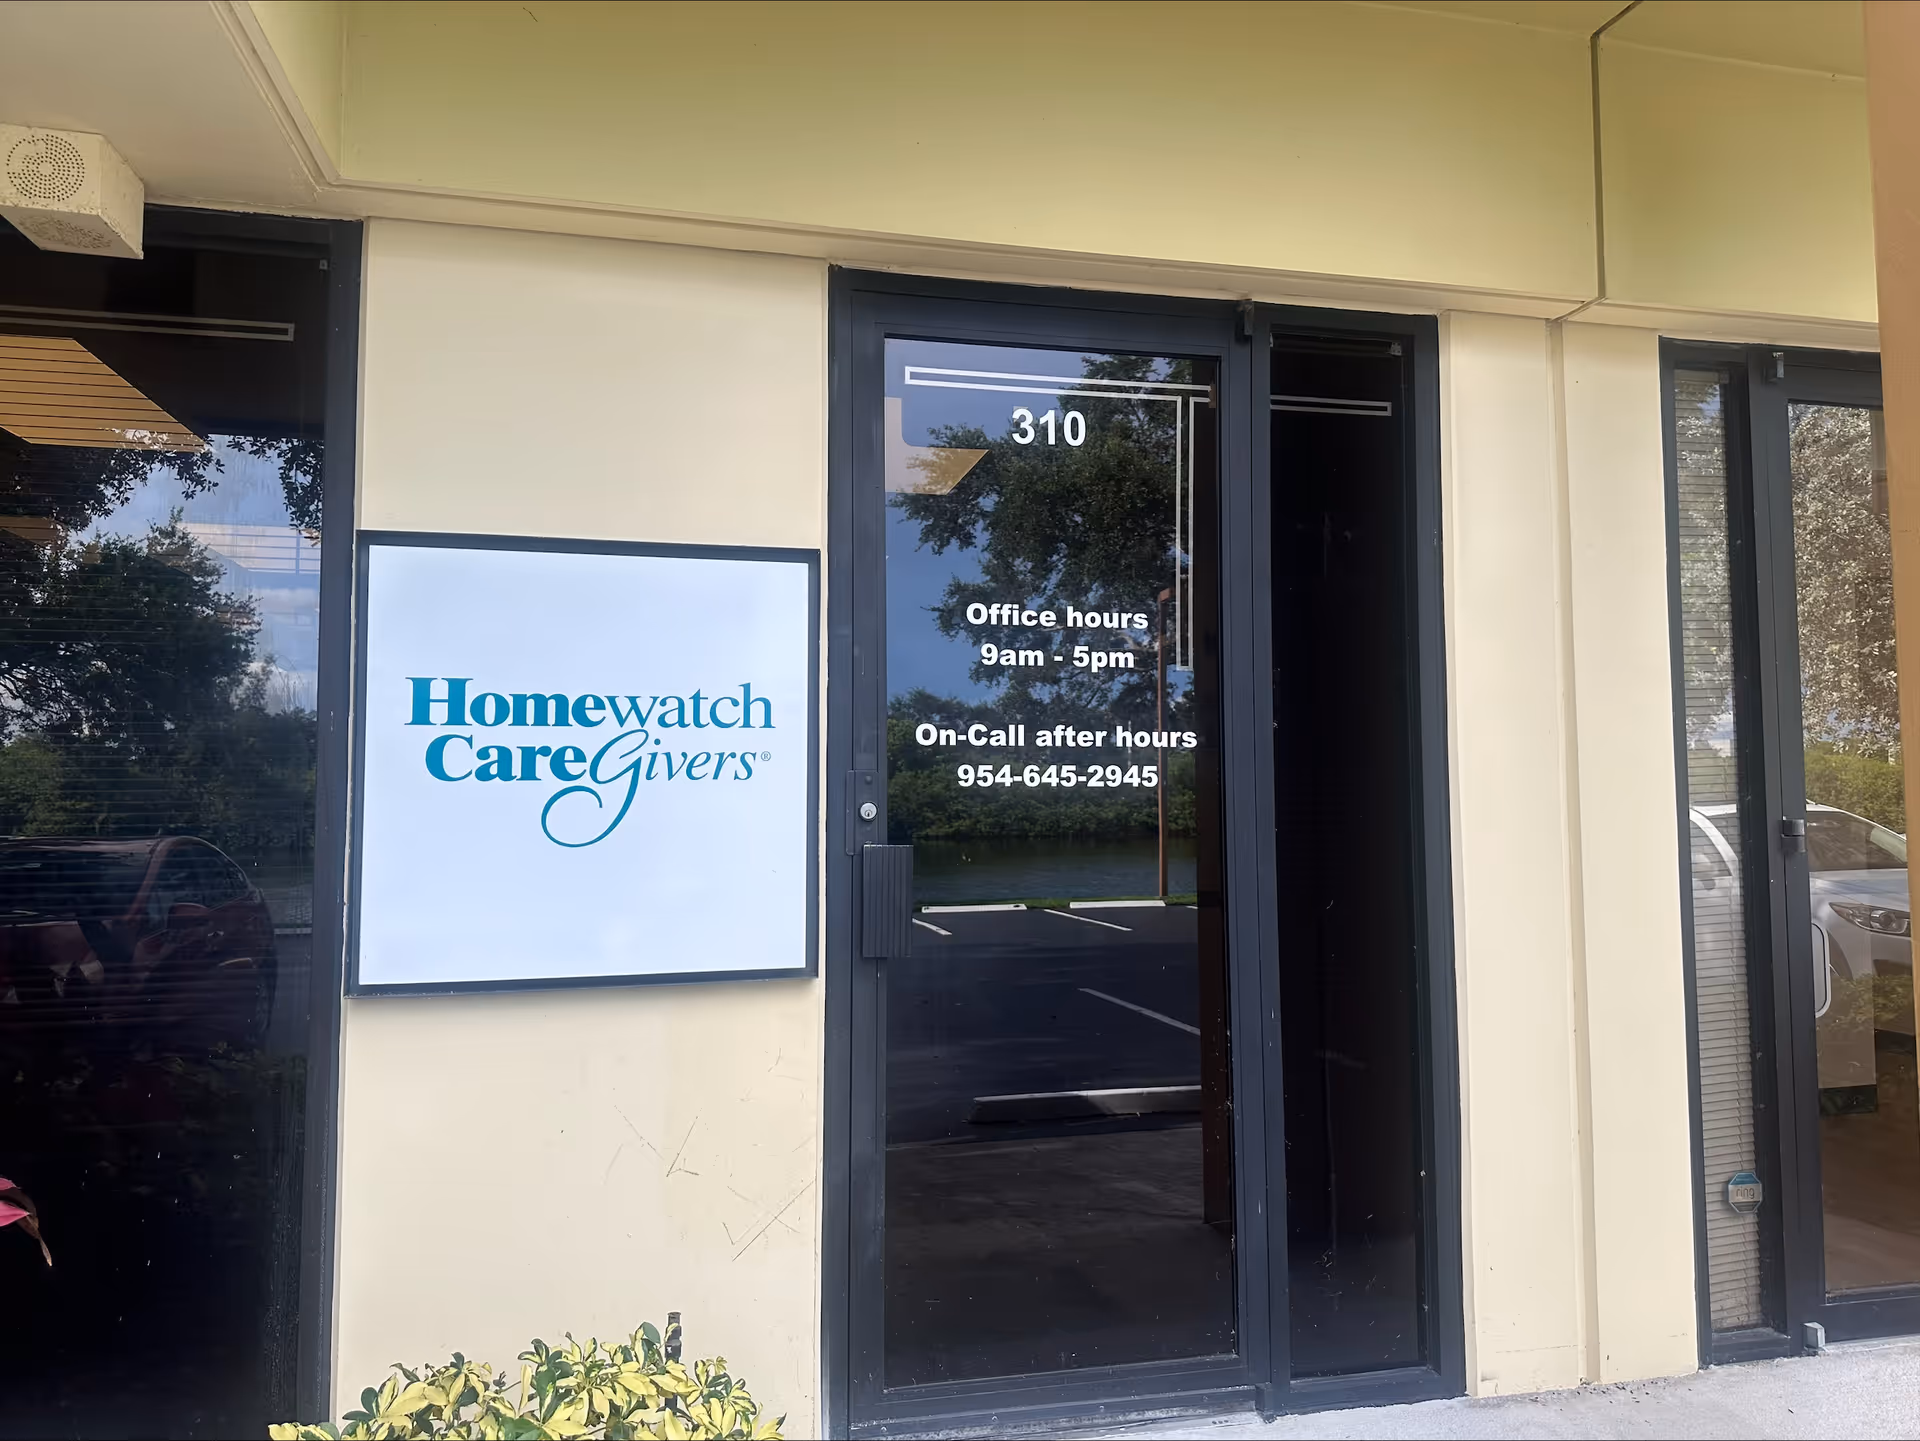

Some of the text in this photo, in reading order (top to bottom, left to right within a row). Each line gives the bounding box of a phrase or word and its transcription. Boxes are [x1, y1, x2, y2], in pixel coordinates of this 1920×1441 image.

[1011, 407, 1087, 447] 310
[966, 602, 1149, 630] Office hours
[980, 643, 1044, 667] 9am
[1072, 645, 1135, 673] 5pm
[404, 676, 776, 729] Homewatch
[915, 722, 1198, 748] On-Call after hours
[957, 764, 1159, 788] 954-645-2945
[1736, 1186, 1755, 1199] ring
